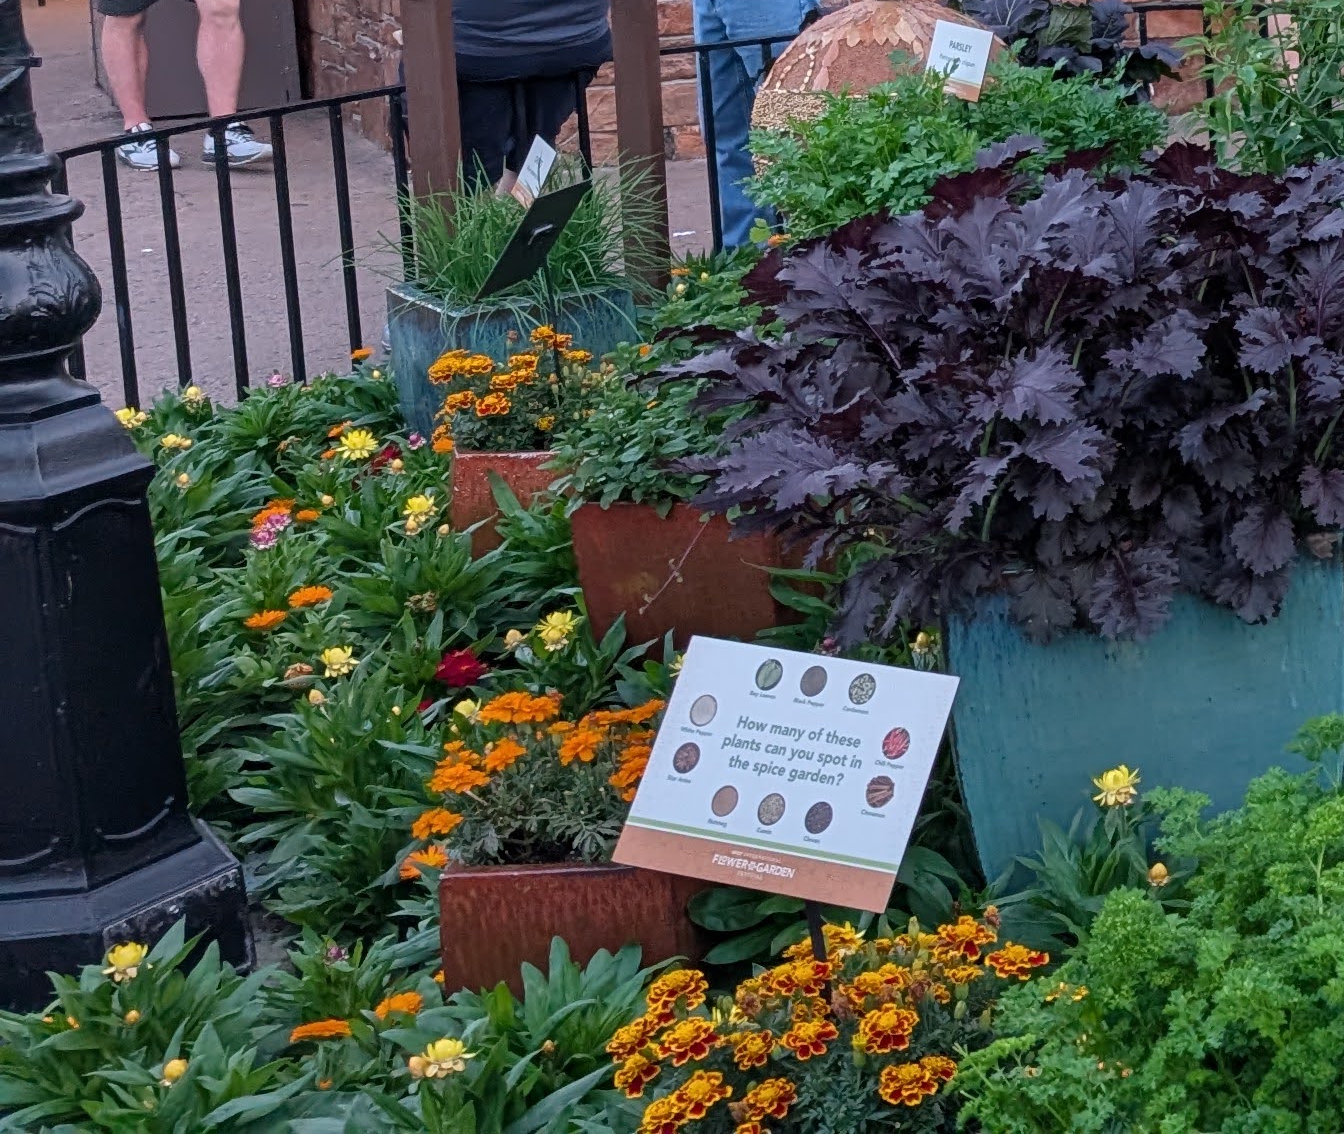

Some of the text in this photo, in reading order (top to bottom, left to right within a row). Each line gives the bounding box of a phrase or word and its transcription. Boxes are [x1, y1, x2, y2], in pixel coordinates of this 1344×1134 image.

[948, 40, 973, 54] PARSLEY
[736, 715, 862, 749] How many of these
[720, 733, 863, 770] plants can you spot in
[728, 754, 846, 787] the spice garden?
[711, 853, 749, 871] FLOWER
[756, 862, 796, 879] GARDEN
